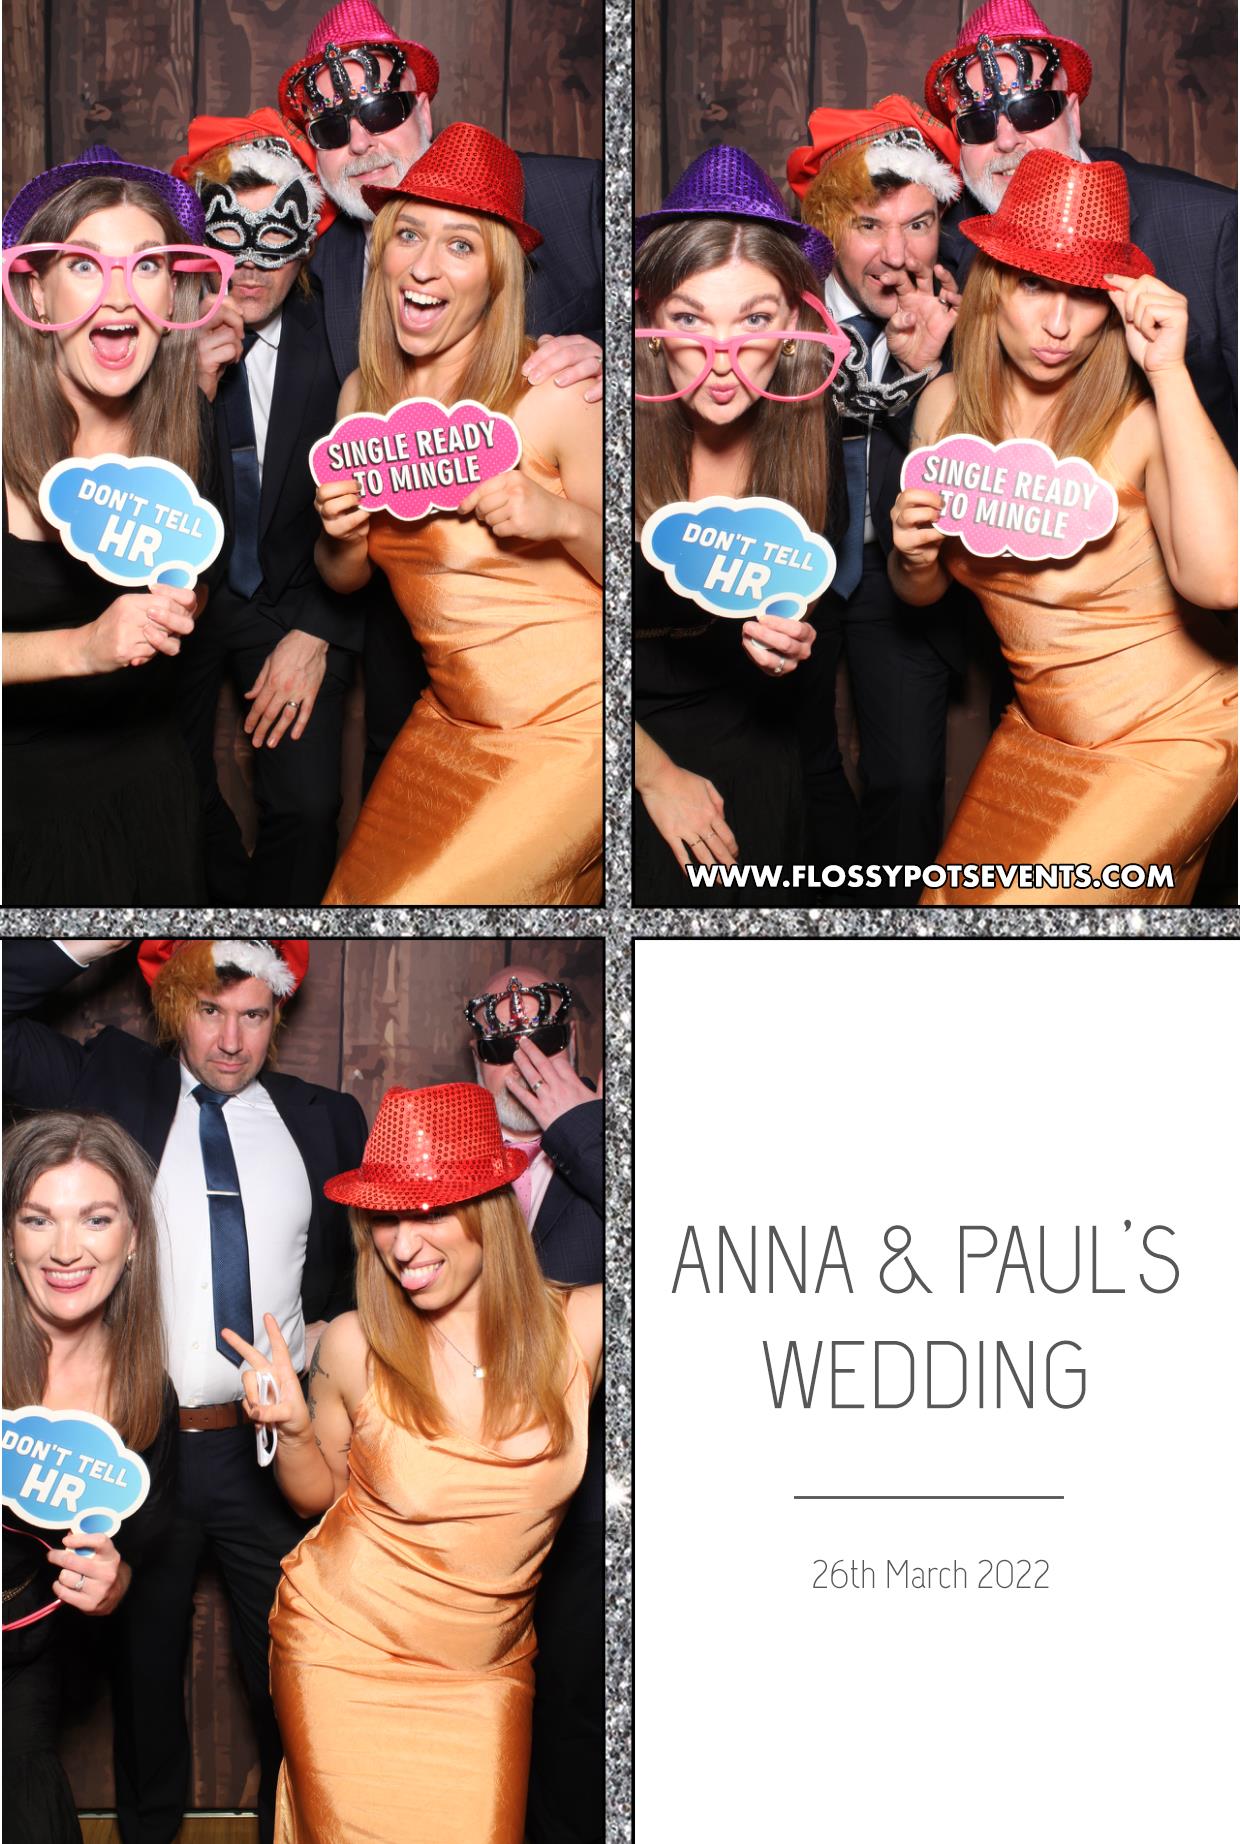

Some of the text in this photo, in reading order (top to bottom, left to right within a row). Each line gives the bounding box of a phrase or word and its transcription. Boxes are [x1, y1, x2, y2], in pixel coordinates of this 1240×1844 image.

[328, 419, 496, 471] SINGLE READY
[352, 455, 481, 497] TO MINGLE
[922, 455, 1100, 511] SINGLE READY
[77, 478, 204, 539] DON'T TELL
[939, 489, 1070, 540] TO MINGLE
[97, 513, 163, 568] HR
[682, 522, 814, 572] DON'T TELL
[703, 554, 771, 600] HR
[2, 1429, 129, 1489] DON'T TELL
[20, 1463, 87, 1513] HR
